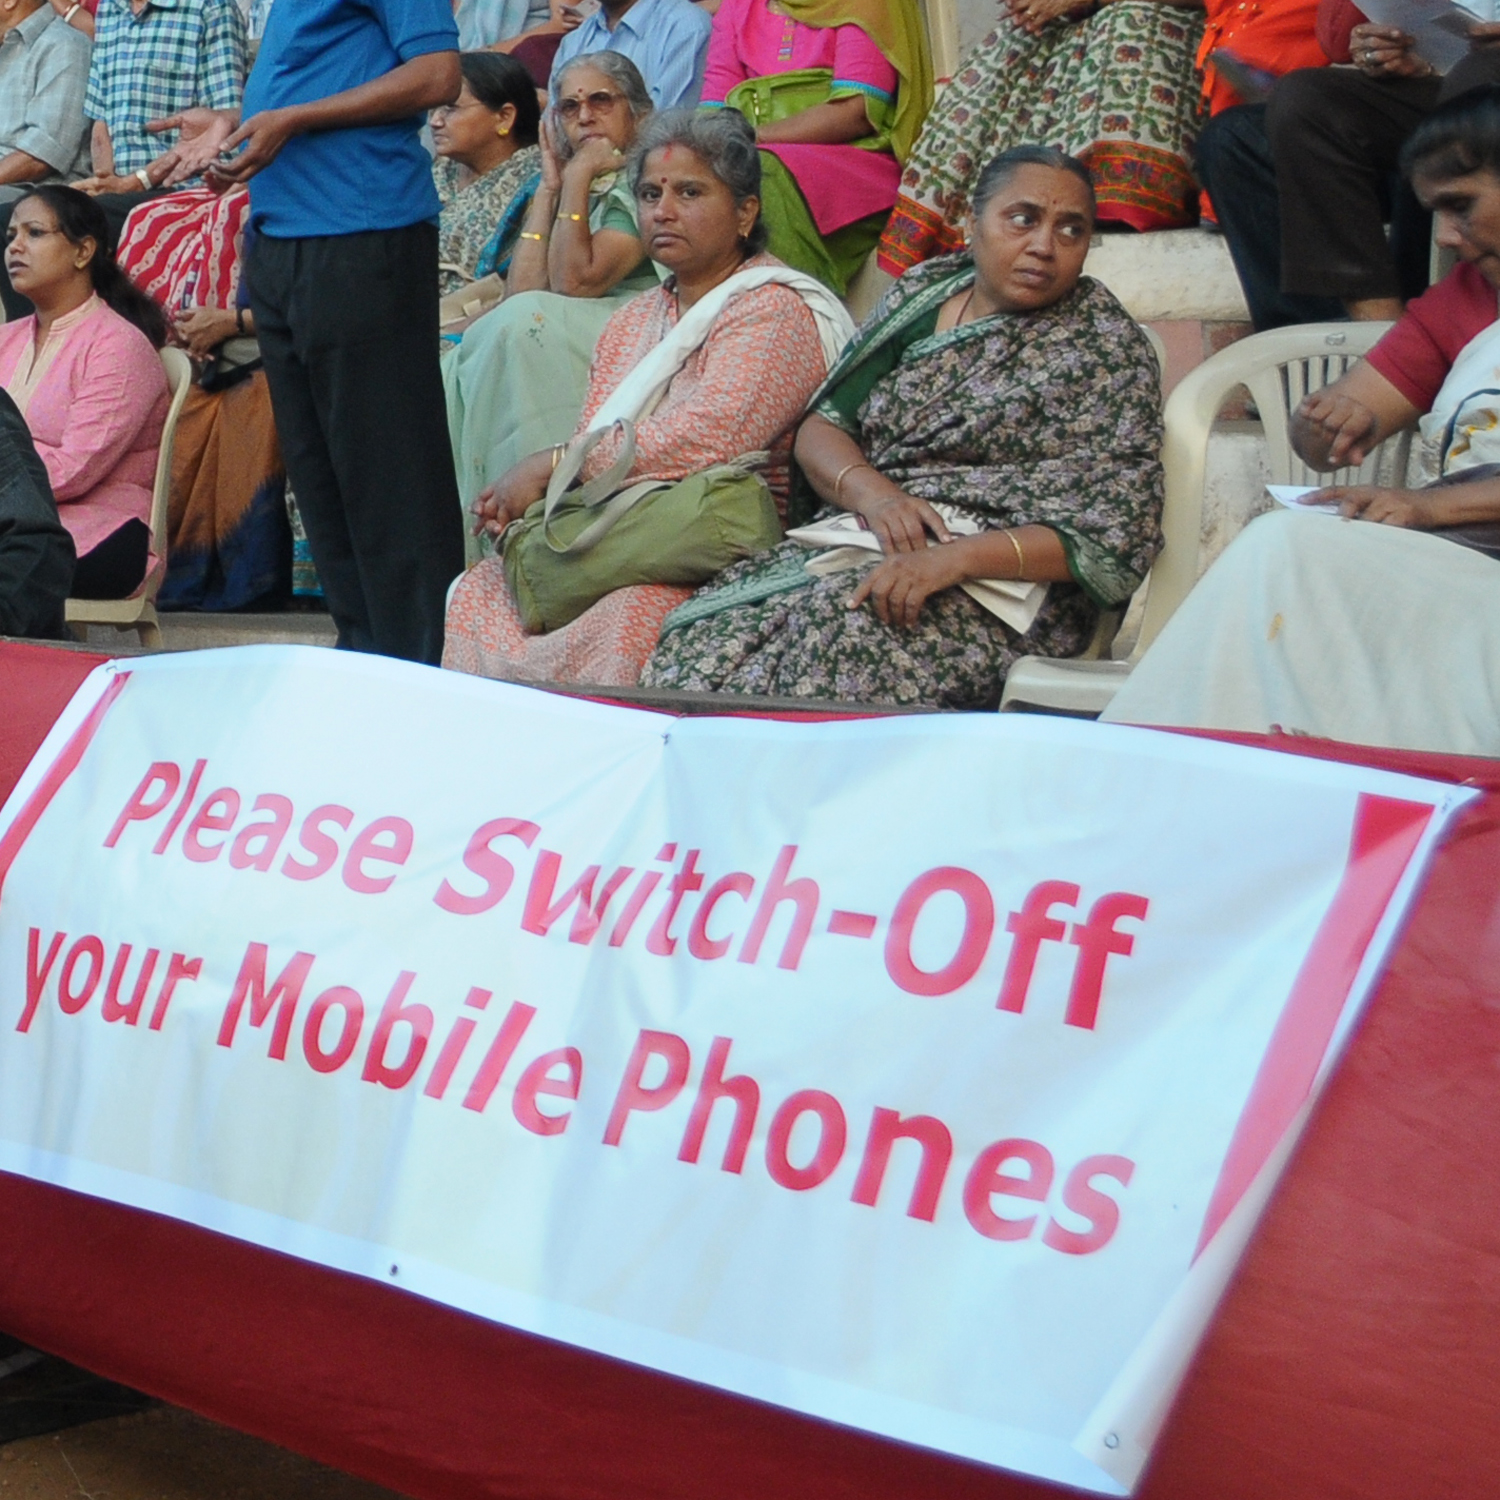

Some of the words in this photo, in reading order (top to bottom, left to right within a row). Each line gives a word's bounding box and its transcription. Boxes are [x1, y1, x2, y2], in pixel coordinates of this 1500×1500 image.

[103, 758, 414, 896] Please
[434, 816, 1150, 1032] Switch-Off
[16, 926, 204, 1036] your
[216, 941, 584, 1138] Mobile
[602, 1029, 1136, 1258] Phones
